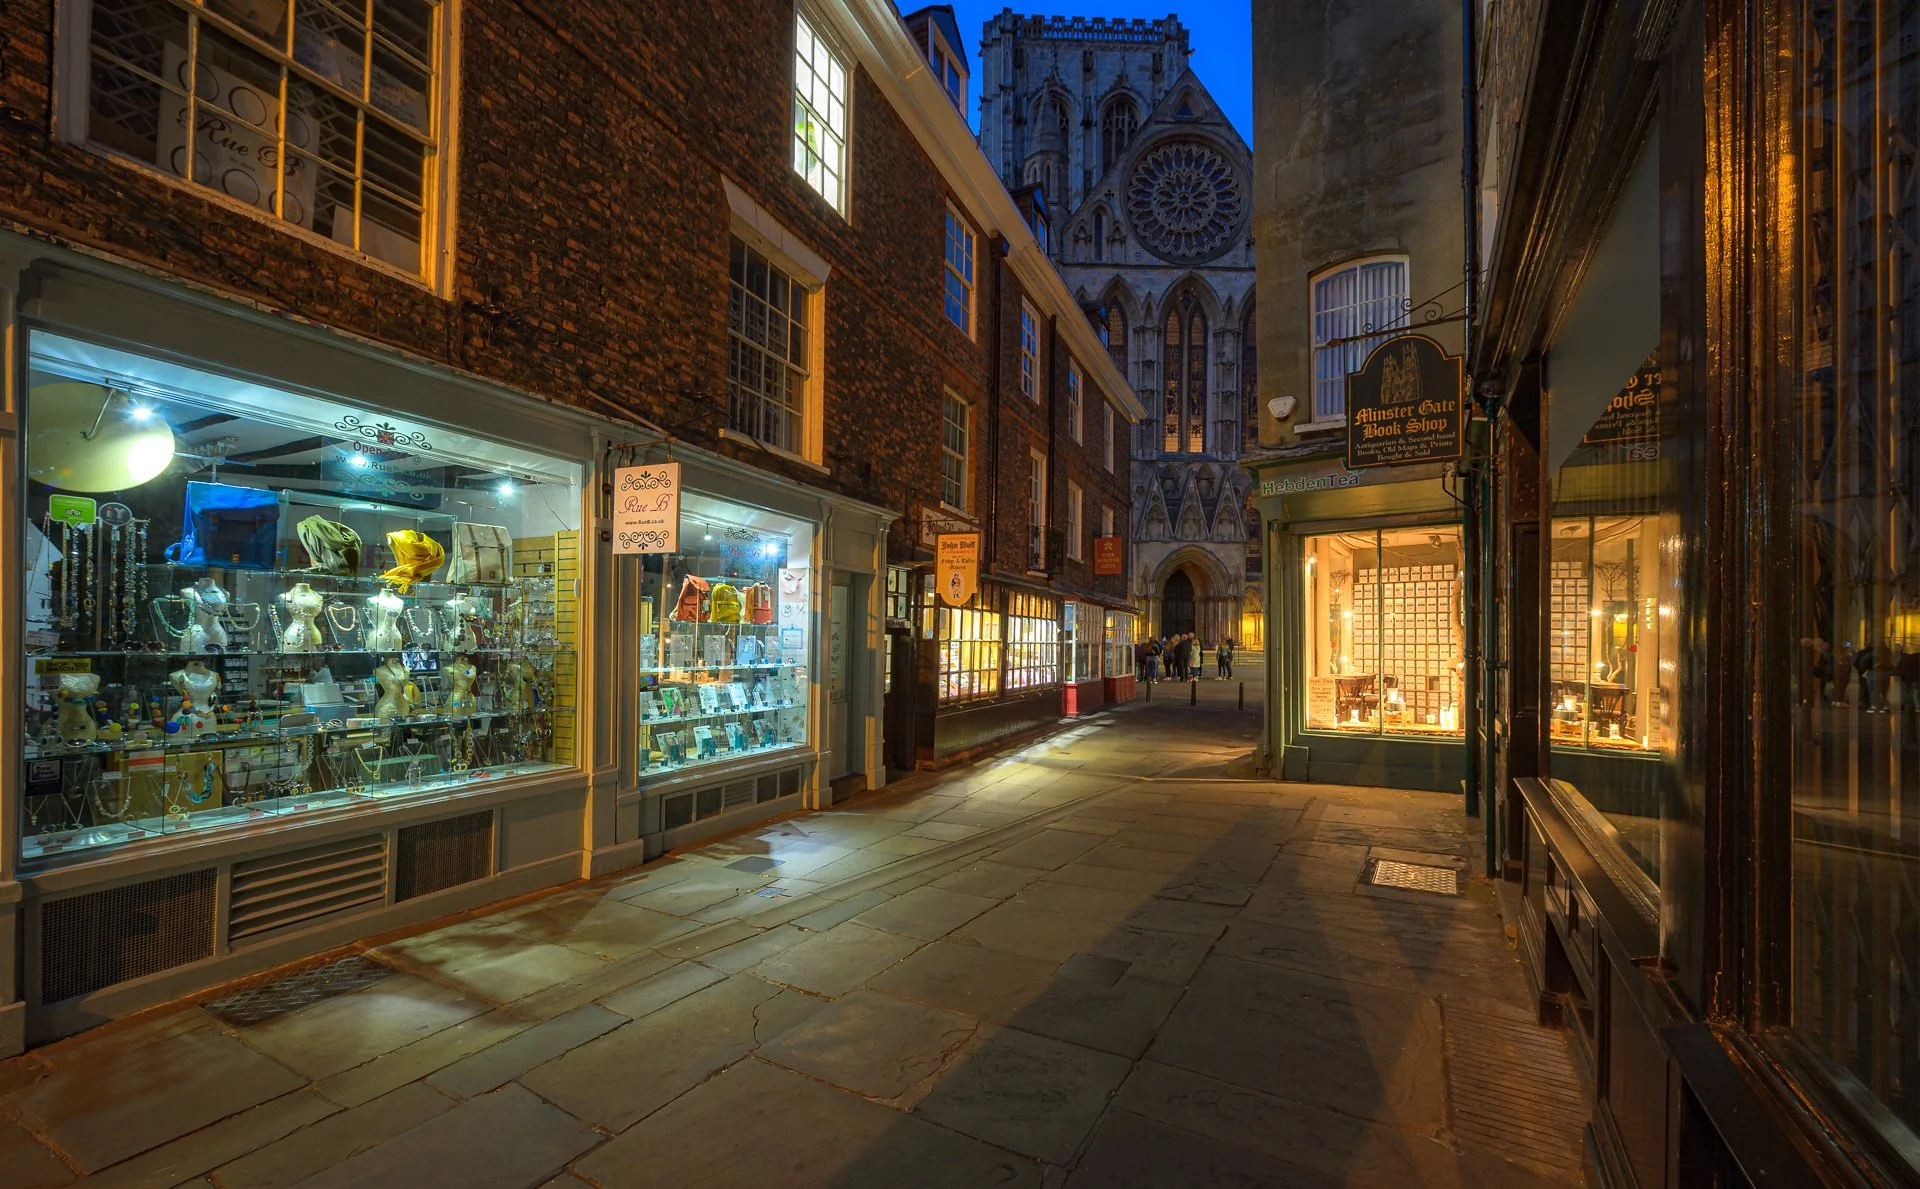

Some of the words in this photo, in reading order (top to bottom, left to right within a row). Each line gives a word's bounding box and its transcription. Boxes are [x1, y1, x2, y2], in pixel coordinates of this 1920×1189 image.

[1354, 405, 1414, 426] Minster
[1418, 399, 1456, 416] Gate
[1362, 421, 1401, 440] Book
[1405, 417, 1448, 434] Shop
[353, 441, 383, 455] Open
[1354, 440, 1397, 450] Antiquarian
[1408, 433, 1435, 443] Second
[1383, 445, 1396, 453] Old
[1398, 444, 1418, 454] Maps
[1430, 440, 1453, 449] Prints
[1377, 453, 1402, 462] Bought
[1415, 448, 1431, 456] Sold
[1261, 472, 1360, 497] HebdenTea
[618, 495, 648, 514] Rue
[650, 493, 674, 512] B
